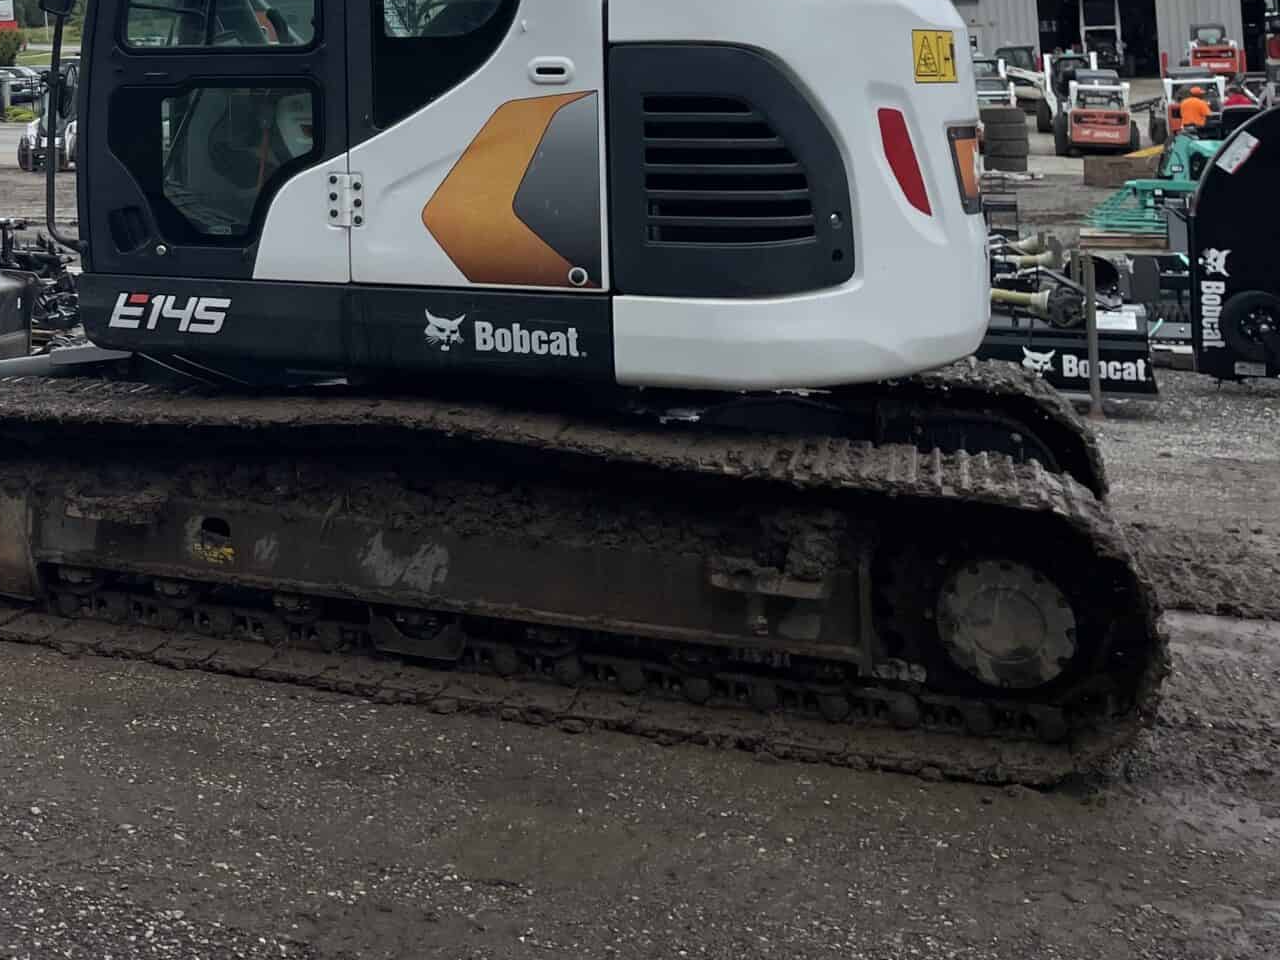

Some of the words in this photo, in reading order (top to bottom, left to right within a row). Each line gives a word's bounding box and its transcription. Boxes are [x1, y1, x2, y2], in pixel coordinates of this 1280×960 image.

[108, 292, 232, 334] E145
[1200, 280, 1225, 348] Bobcat
[474, 320, 580, 357] Bobcat
